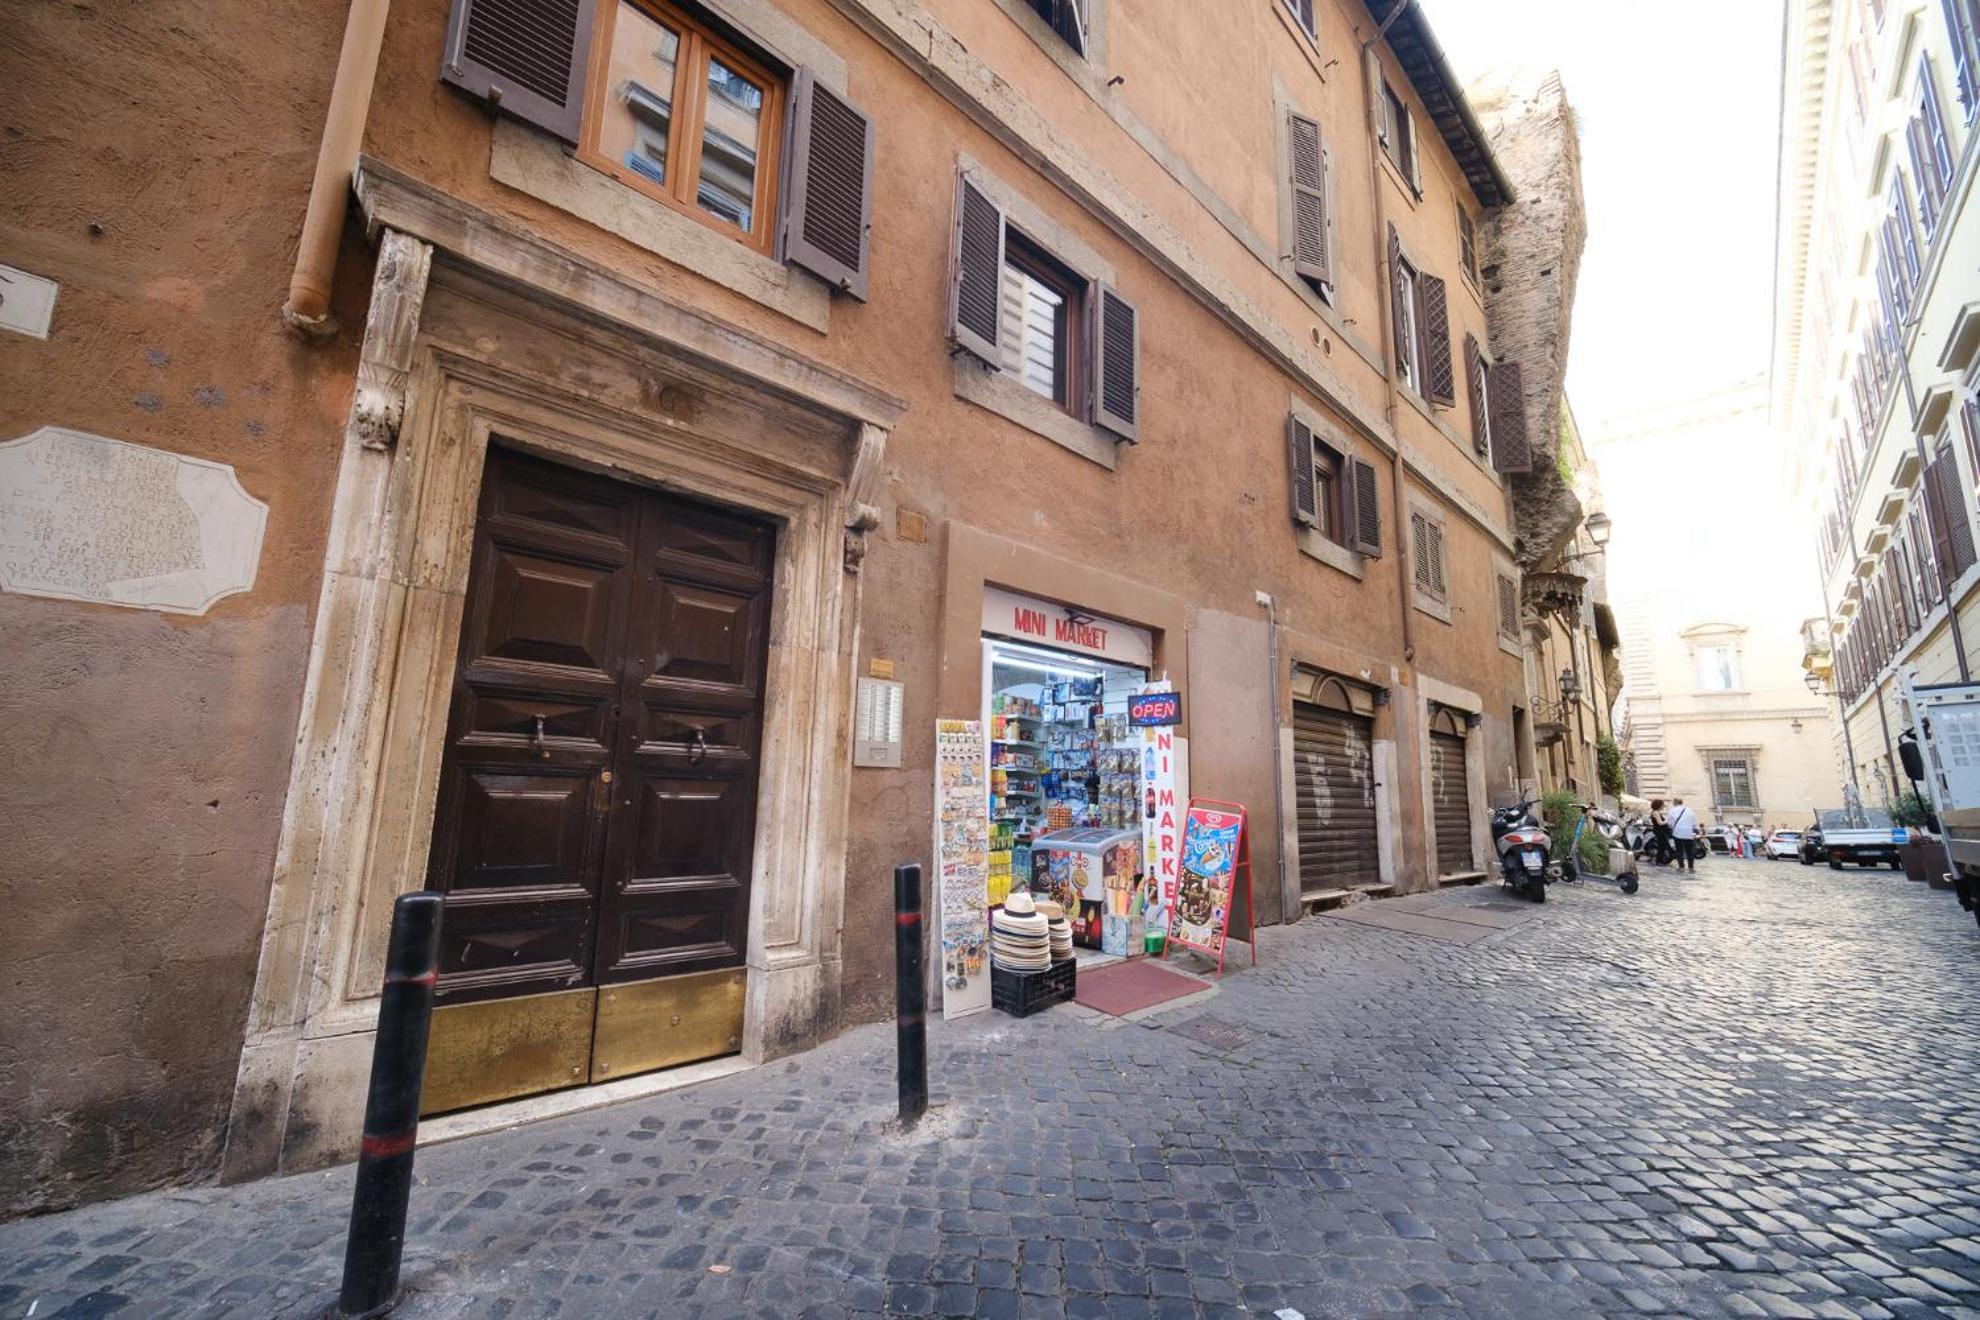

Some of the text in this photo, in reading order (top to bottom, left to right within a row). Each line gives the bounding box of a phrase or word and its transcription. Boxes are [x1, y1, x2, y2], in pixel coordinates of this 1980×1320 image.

[1015, 606, 1107, 650] MINI MARKET
[1132, 701, 1175, 718] OPEN
